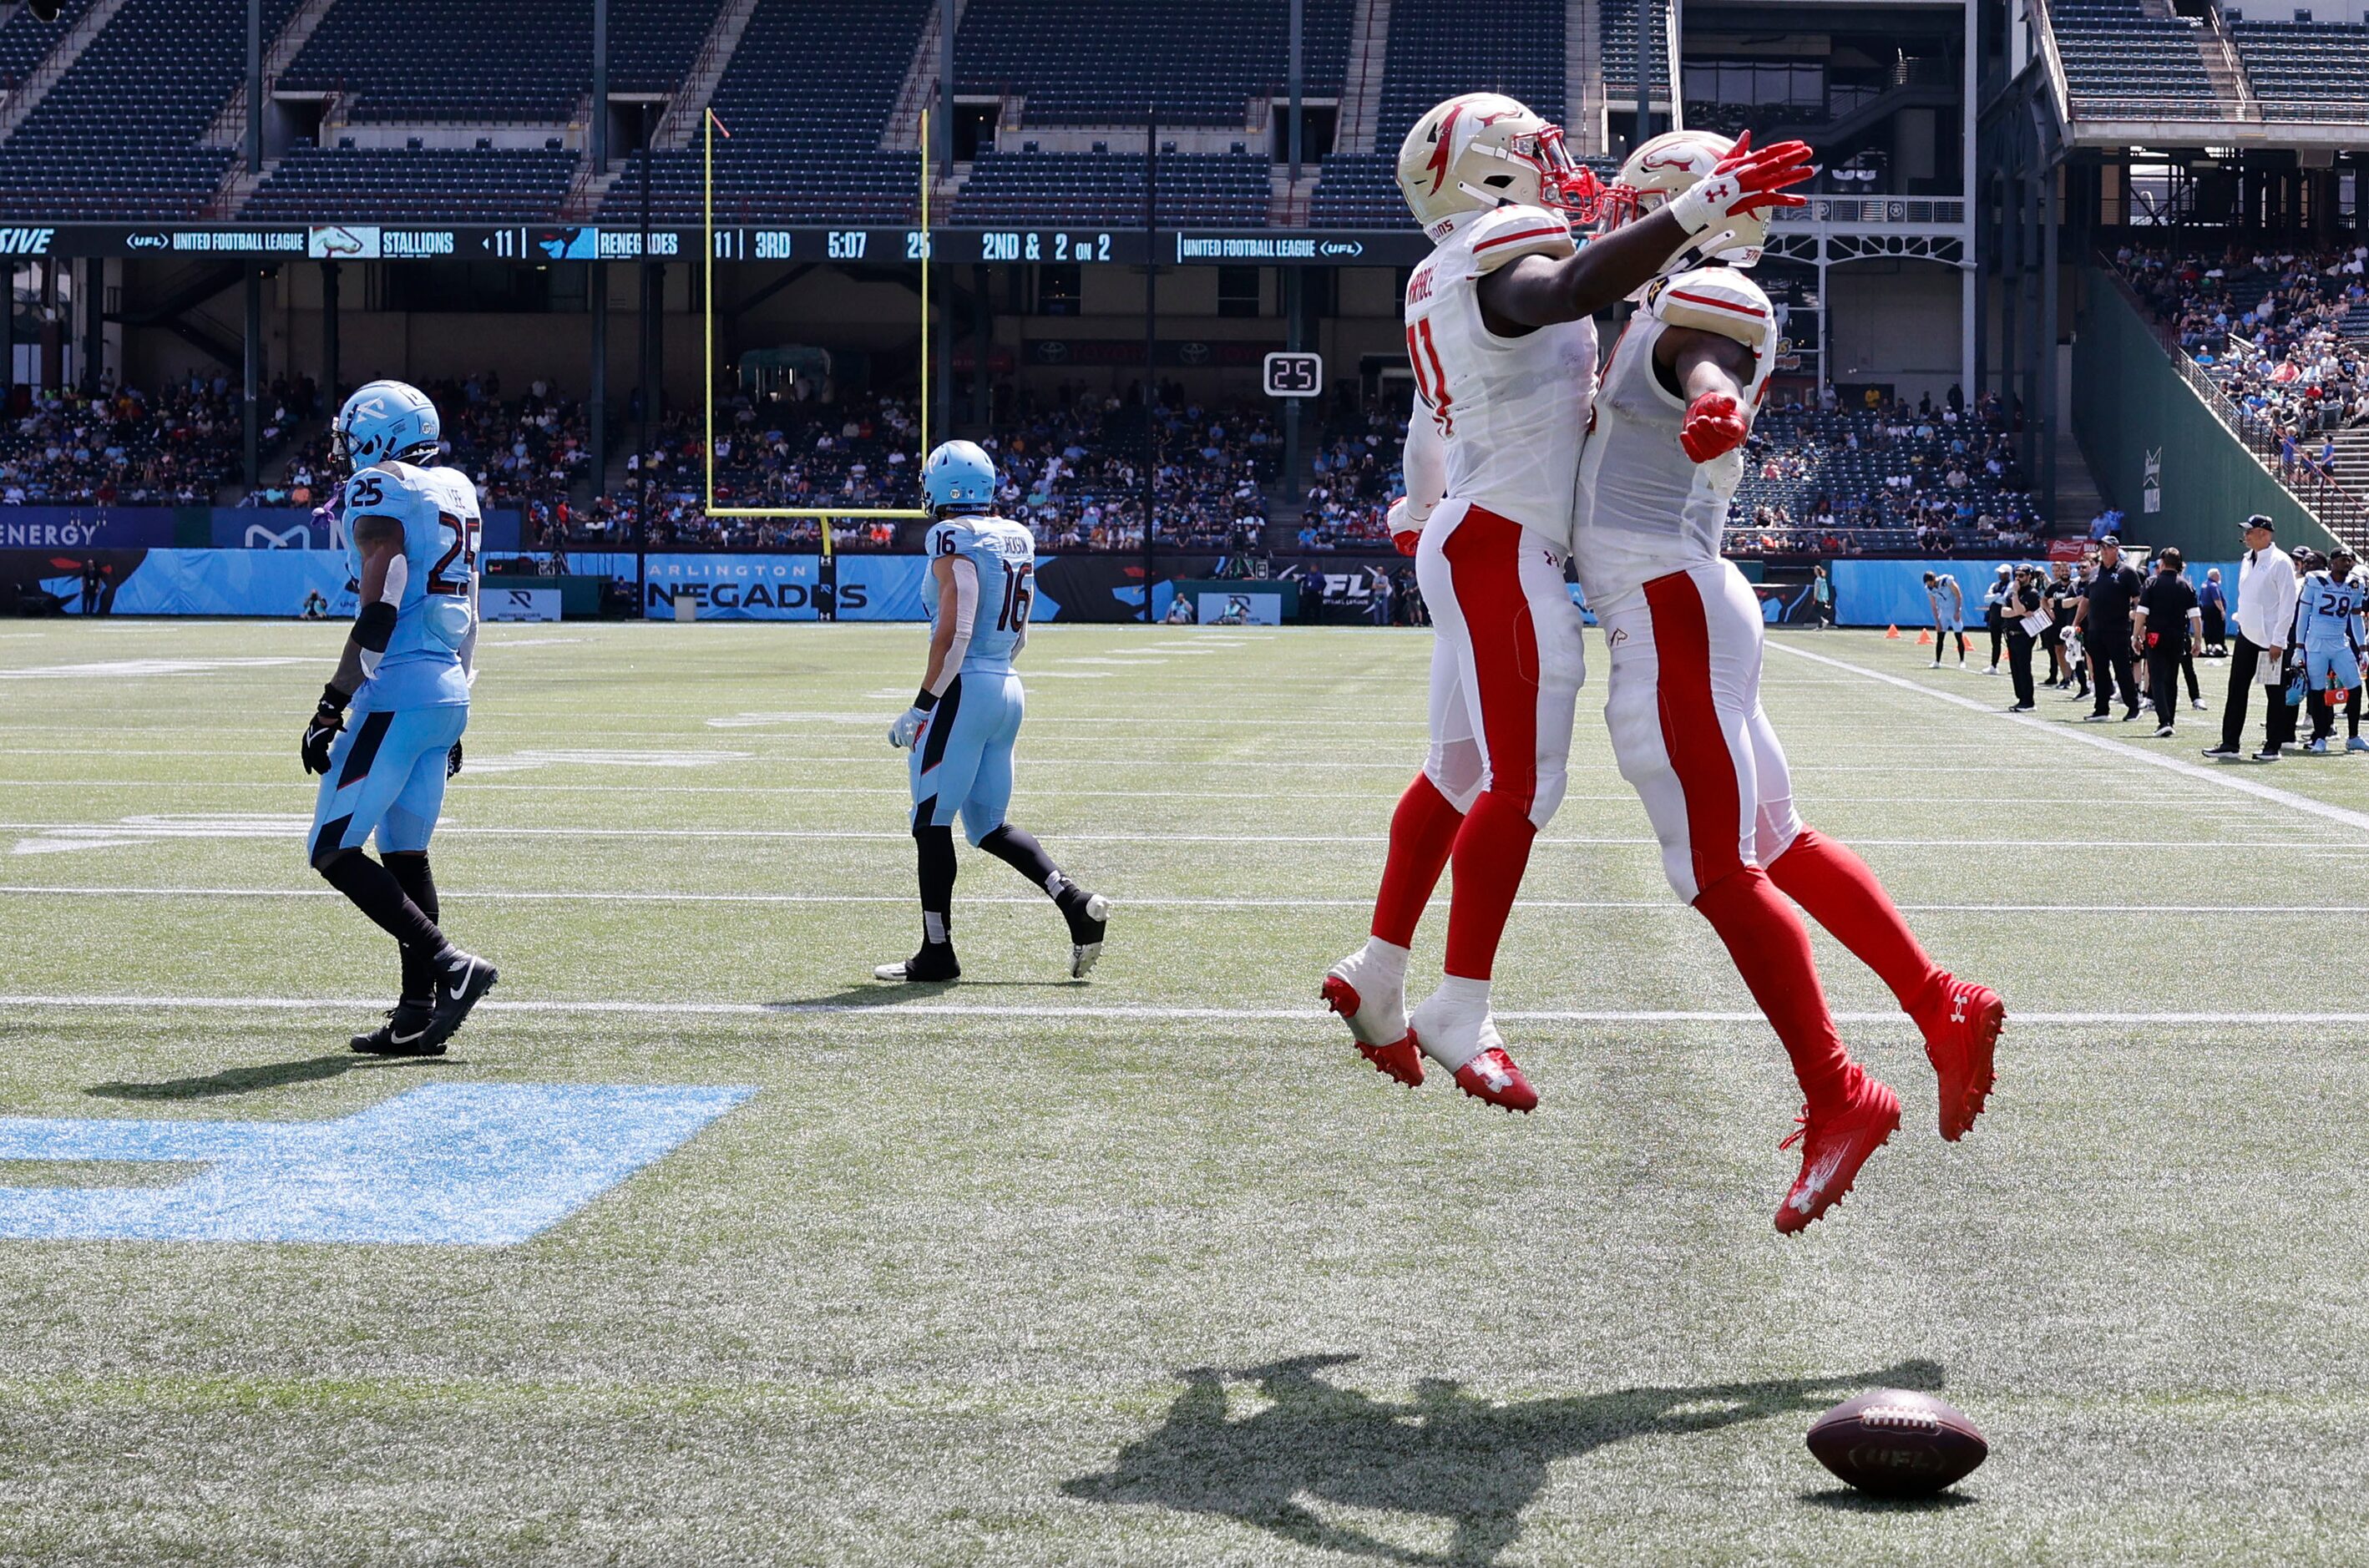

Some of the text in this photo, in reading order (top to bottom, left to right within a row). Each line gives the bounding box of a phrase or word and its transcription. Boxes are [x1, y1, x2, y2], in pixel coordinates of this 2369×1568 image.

[173, 233, 210, 250] UNITED
[212, 233, 263, 250] FOOTBALL
[265, 233, 303, 250] LEAGUE
[382, 230, 513, 257] STALLIONS 11
[714, 231, 731, 258] 11
[756, 231, 791, 259] 3RD
[828, 231, 867, 259] 5:07
[983, 233, 1020, 260] 2ND
[1025, 233, 1040, 260] &
[1055, 233, 1067, 260] 2
[1098, 233, 1110, 260] 2
[1183, 239, 1221, 256] UNITED
[1223, 239, 1275, 256] FOOTBALL
[1277, 239, 1316, 256] LEAGUE
[1274, 360, 1312, 388] 25
[352, 478, 383, 507] 25
[936, 529, 955, 554] 16
[649, 564, 807, 576] ARLINGTON
[996, 559, 1032, 633] 16
[2319, 594, 2351, 618] 28
[2336, 691, 2345, 701] G
